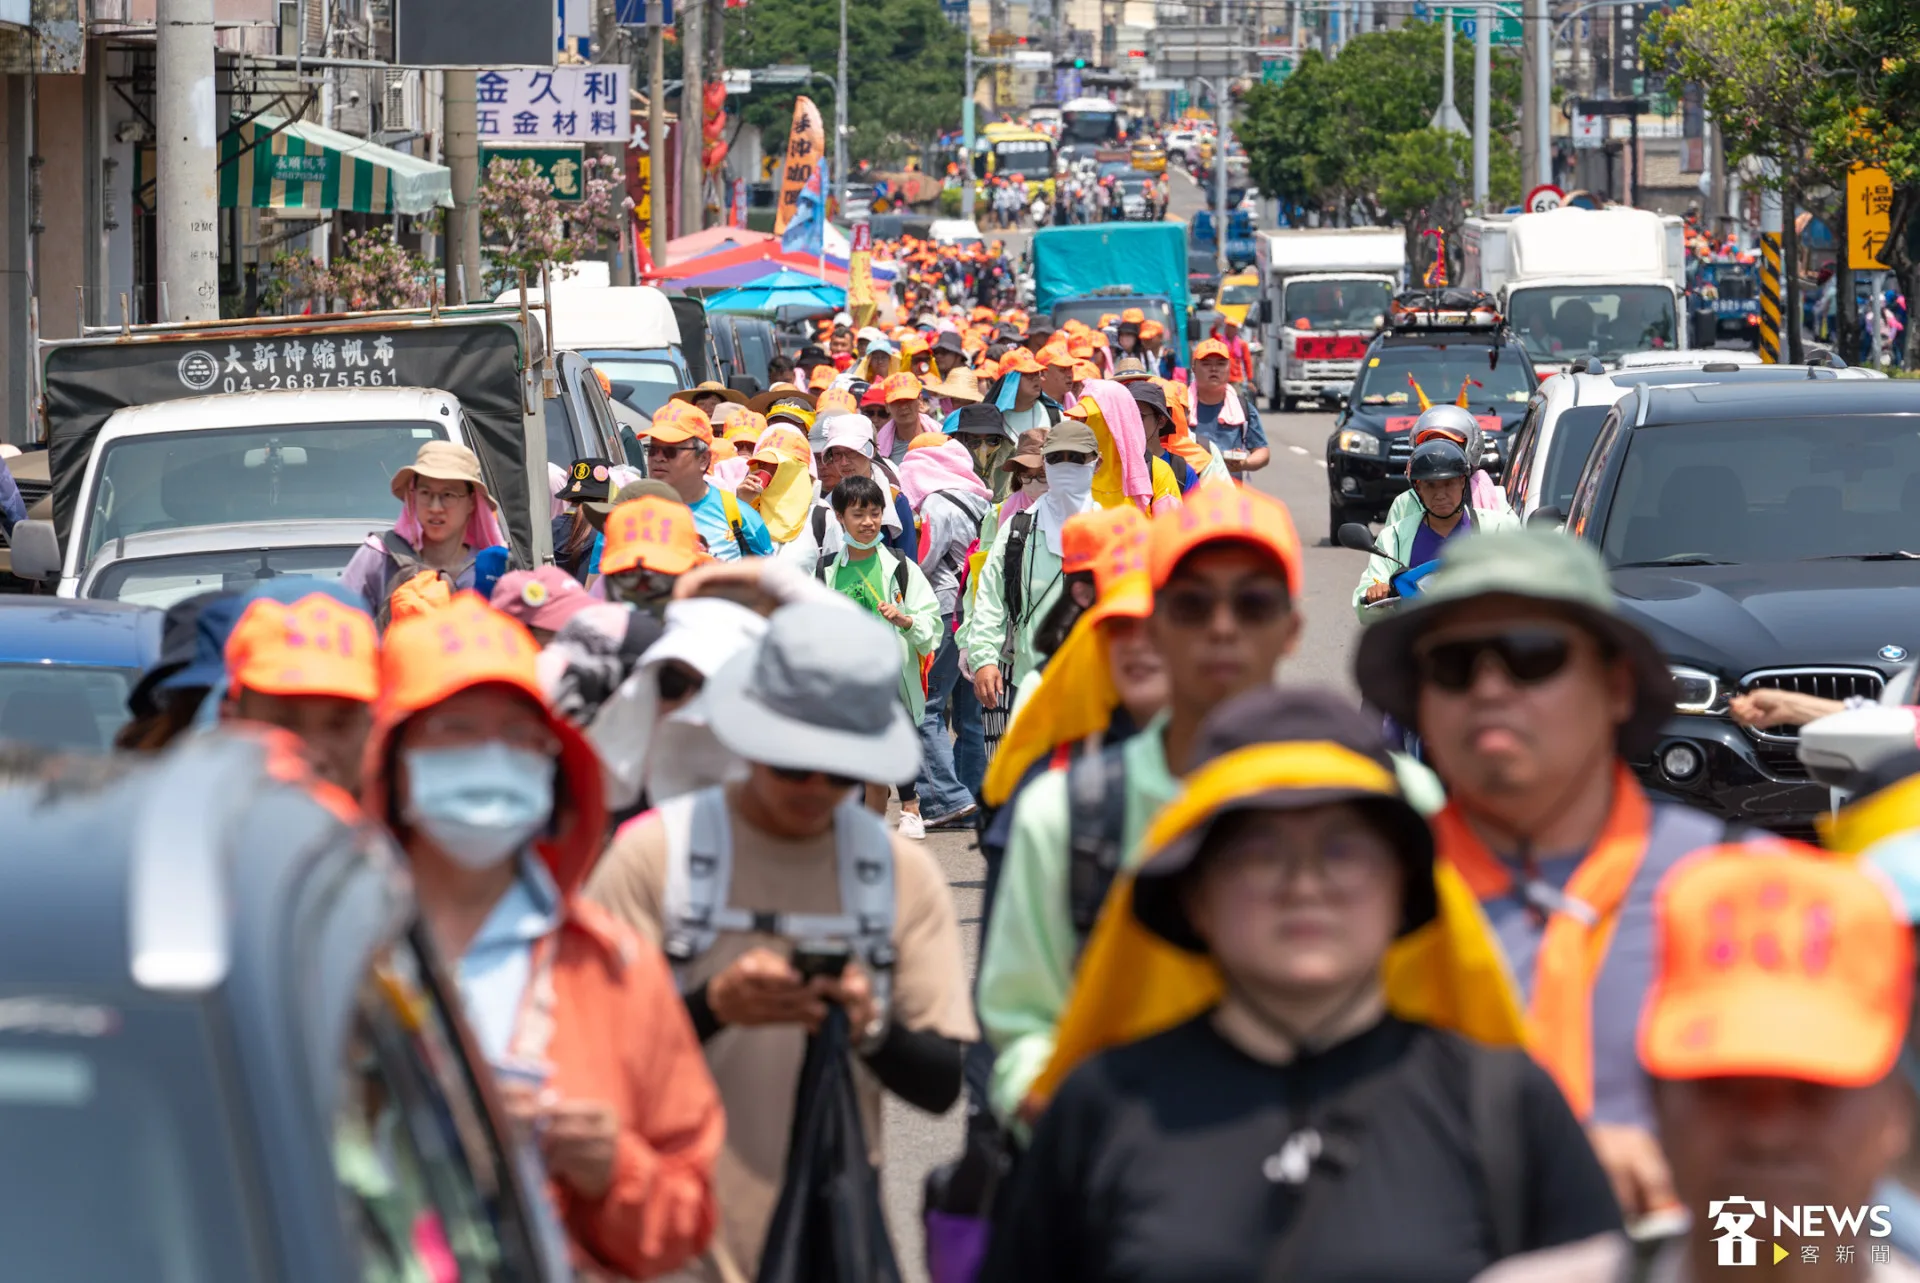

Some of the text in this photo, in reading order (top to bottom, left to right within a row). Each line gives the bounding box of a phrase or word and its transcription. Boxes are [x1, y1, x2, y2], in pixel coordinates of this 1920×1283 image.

[477, 71, 617, 105] 金久利
[477, 110, 617, 136] 五金材料
[224, 335, 396, 374] 大新伸縮帆布
[224, 368, 397, 394] 04-26875561
